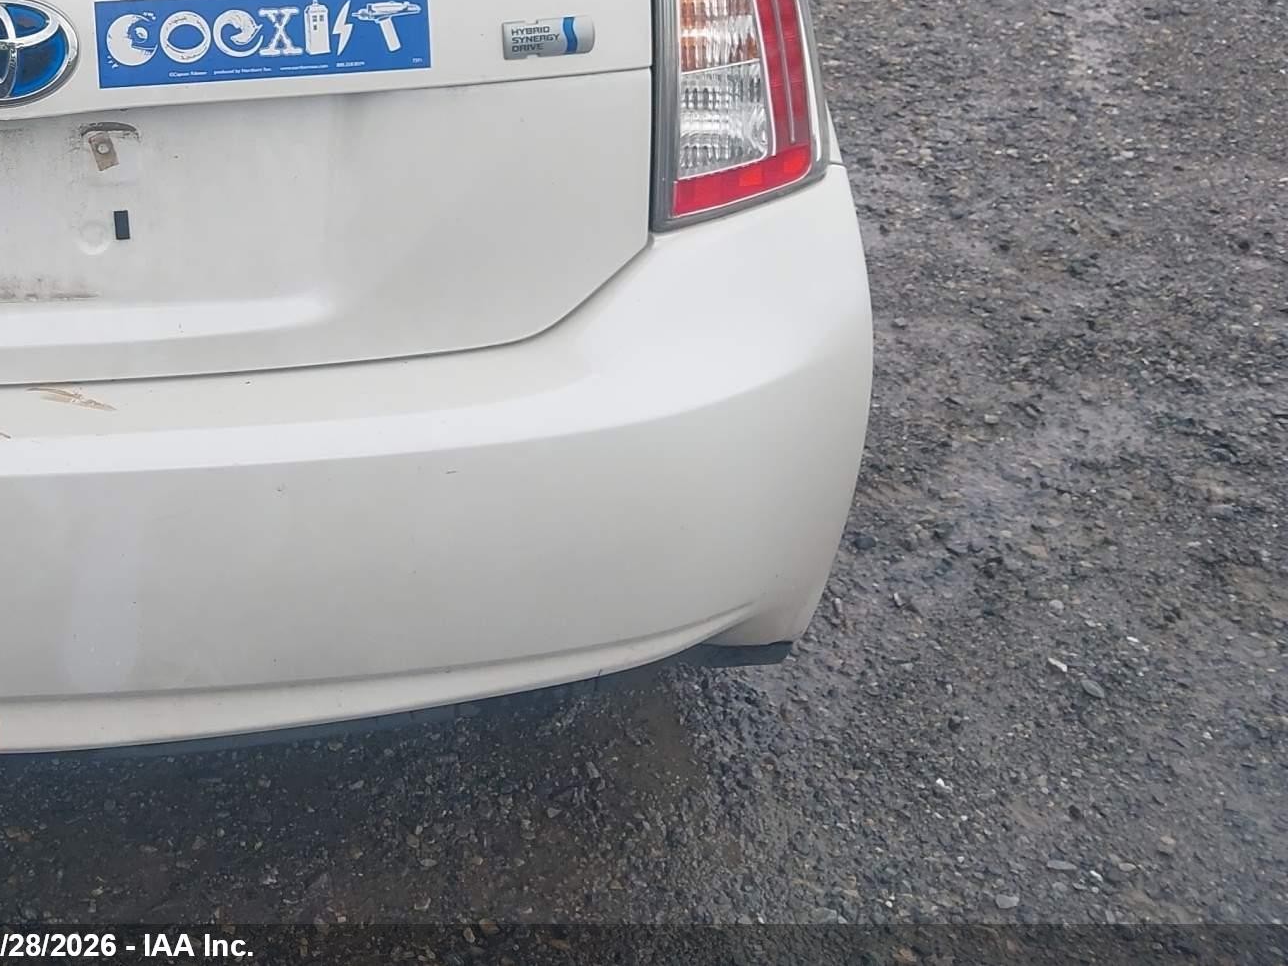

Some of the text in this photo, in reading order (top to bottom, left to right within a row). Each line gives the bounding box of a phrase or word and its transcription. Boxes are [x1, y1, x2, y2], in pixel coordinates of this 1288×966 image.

[511, 26, 550, 36] HYBRID
[511, 33, 560, 44] SYNERGY
[511, 42, 545, 53] DRIVE
